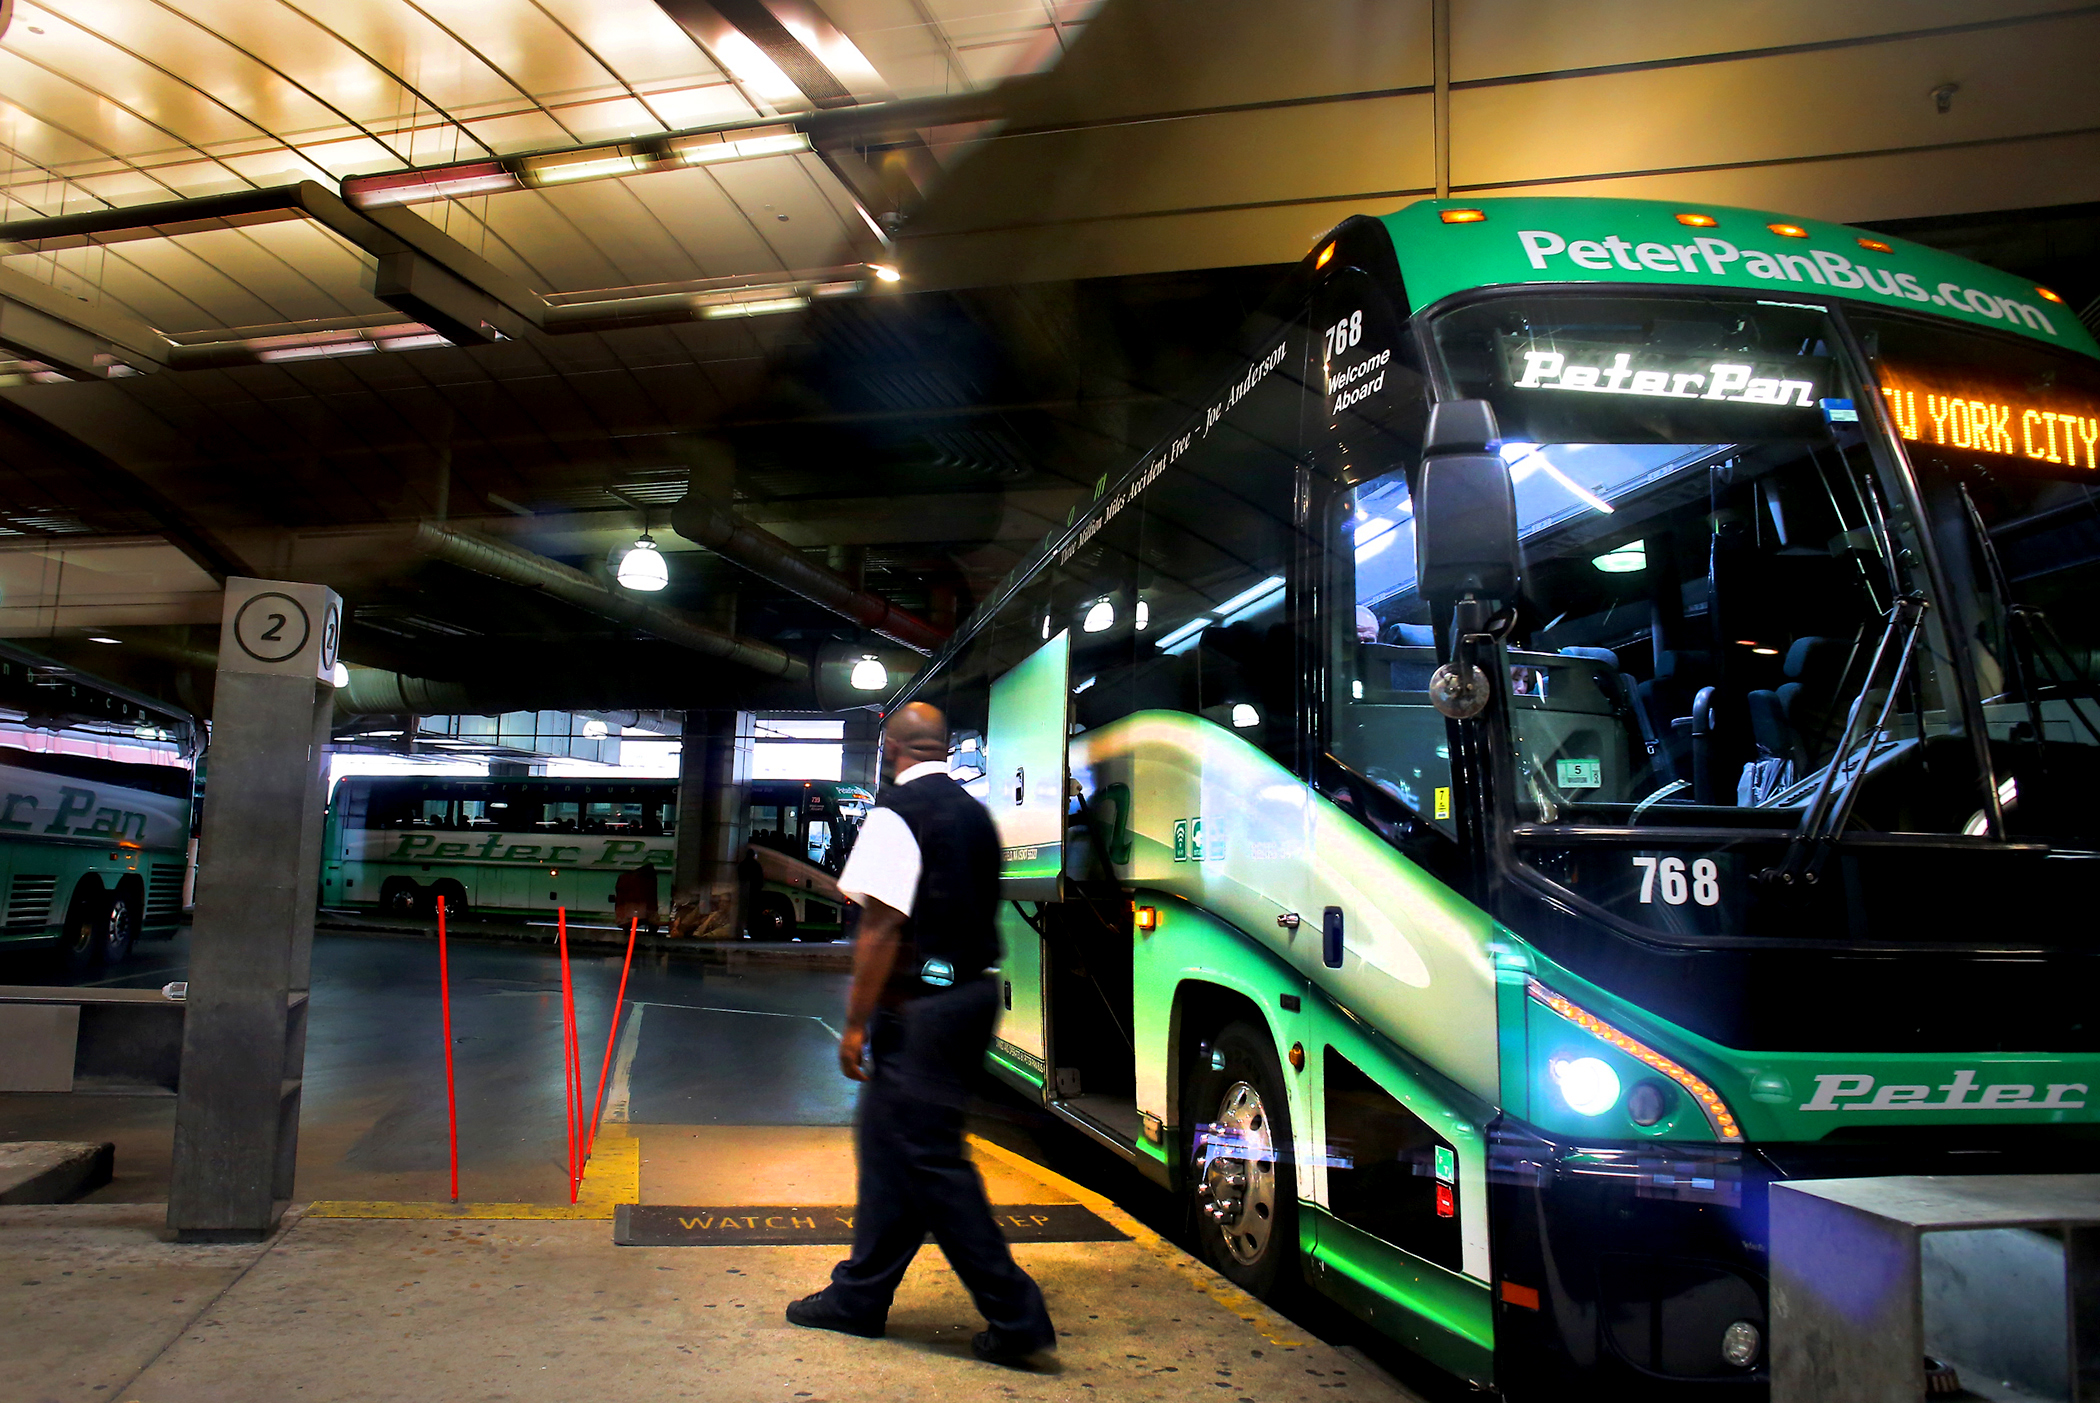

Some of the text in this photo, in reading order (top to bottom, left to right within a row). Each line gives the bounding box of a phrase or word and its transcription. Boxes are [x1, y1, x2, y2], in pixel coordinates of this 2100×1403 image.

[1517, 230, 2057, 335] PeterPanBus.com
[1325, 309, 1363, 362] 768
[1328, 348, 1391, 395] Welcome
[1332, 370, 1386, 415] Aboard
[1104, 493, 1126, 525] Miles
[1126, 453, 1167, 504] Accident
[1169, 432, 1191, 464] Free
[1202, 402, 1222, 439] Joe
[1225, 340, 1287, 412] Anderson
[1927, 394, 2014, 455] YORK
[2022, 408, 2098, 469] CITY
[260, 613, 287, 642] 2
[326, 623, 335, 650] 2
[1574, 765, 1582, 775] 5
[44, 785, 148, 841] Pan
[389, 833, 675, 867] Peter Pa
[1633, 857, 1719, 906] 768
[1799, 1070, 2088, 1111] Peter
[678, 1214, 1050, 1230] WATCH EP
